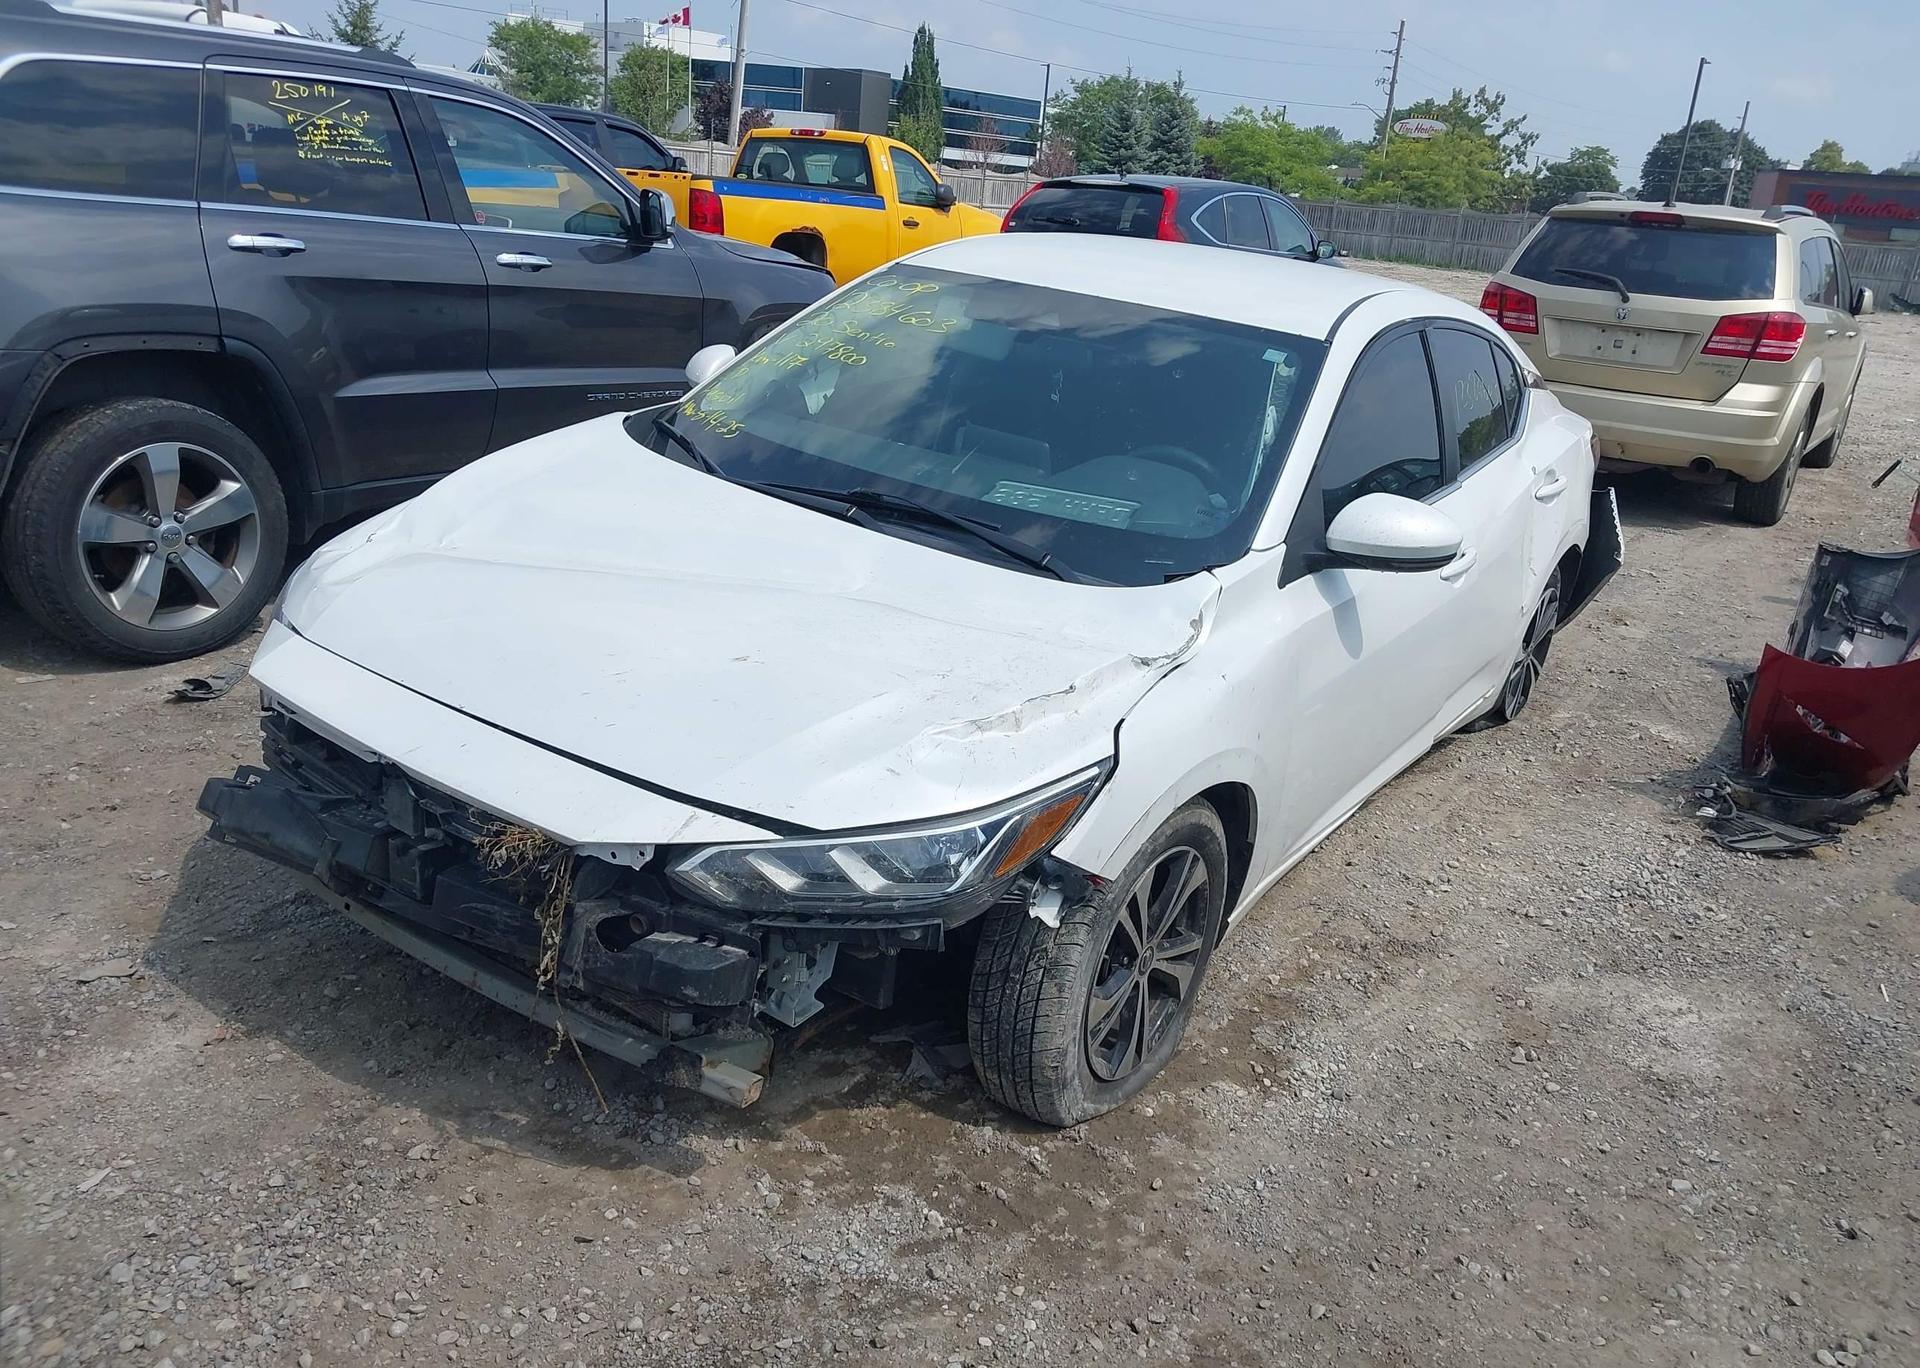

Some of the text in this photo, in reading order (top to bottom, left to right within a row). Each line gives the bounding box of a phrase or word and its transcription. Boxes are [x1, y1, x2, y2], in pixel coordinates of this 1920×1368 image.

[1399, 122, 1412, 134] Tim
[587, 389, 684, 401] GRAND CHEROKEE
